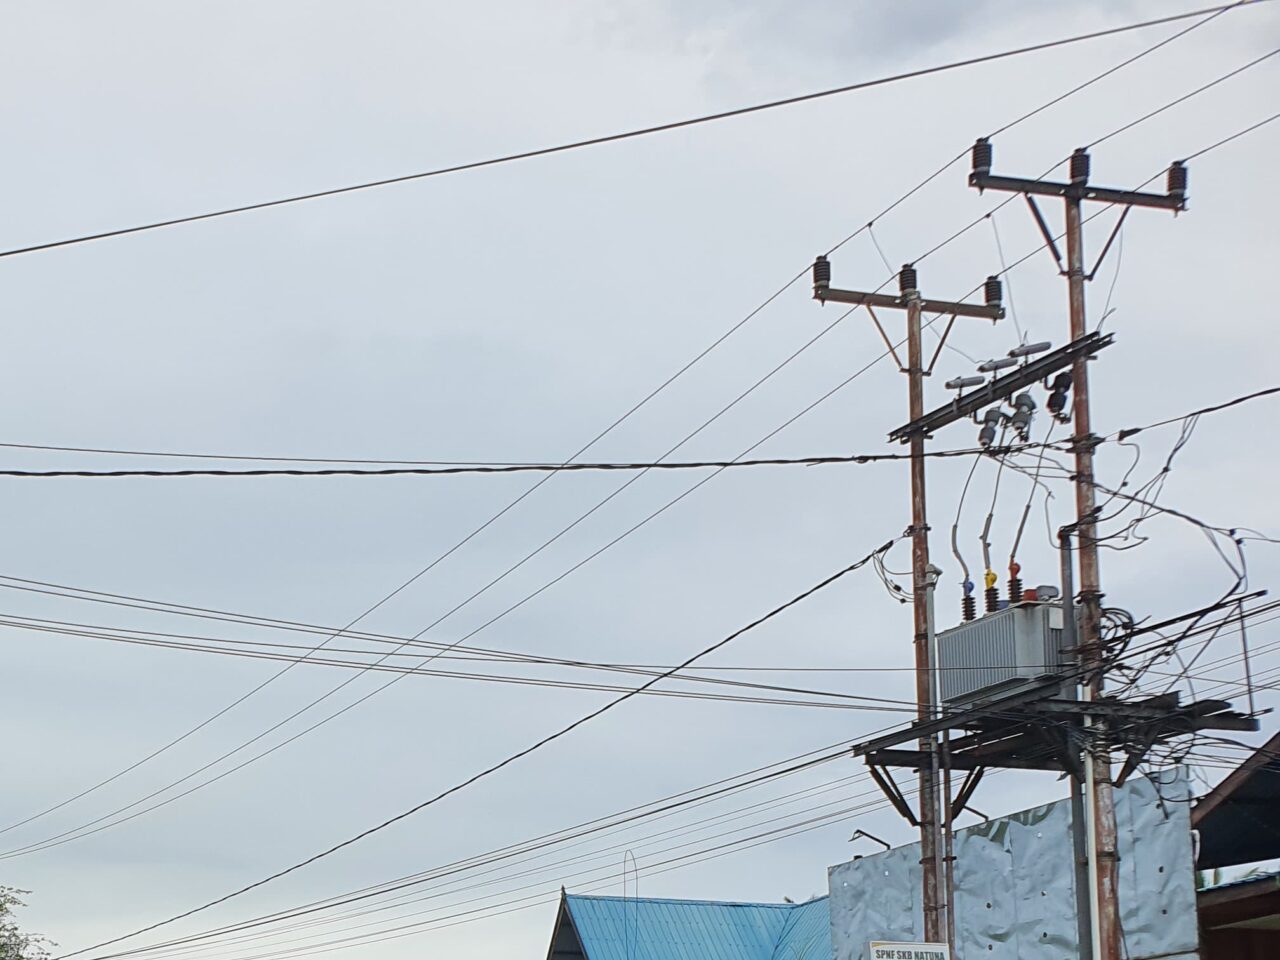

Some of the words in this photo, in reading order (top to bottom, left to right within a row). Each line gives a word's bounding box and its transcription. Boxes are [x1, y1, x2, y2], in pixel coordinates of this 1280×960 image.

[875, 949, 895, 959] SPNF
[896, 950, 912, 960] SKB
[914, 951, 945, 960] NATUNA
